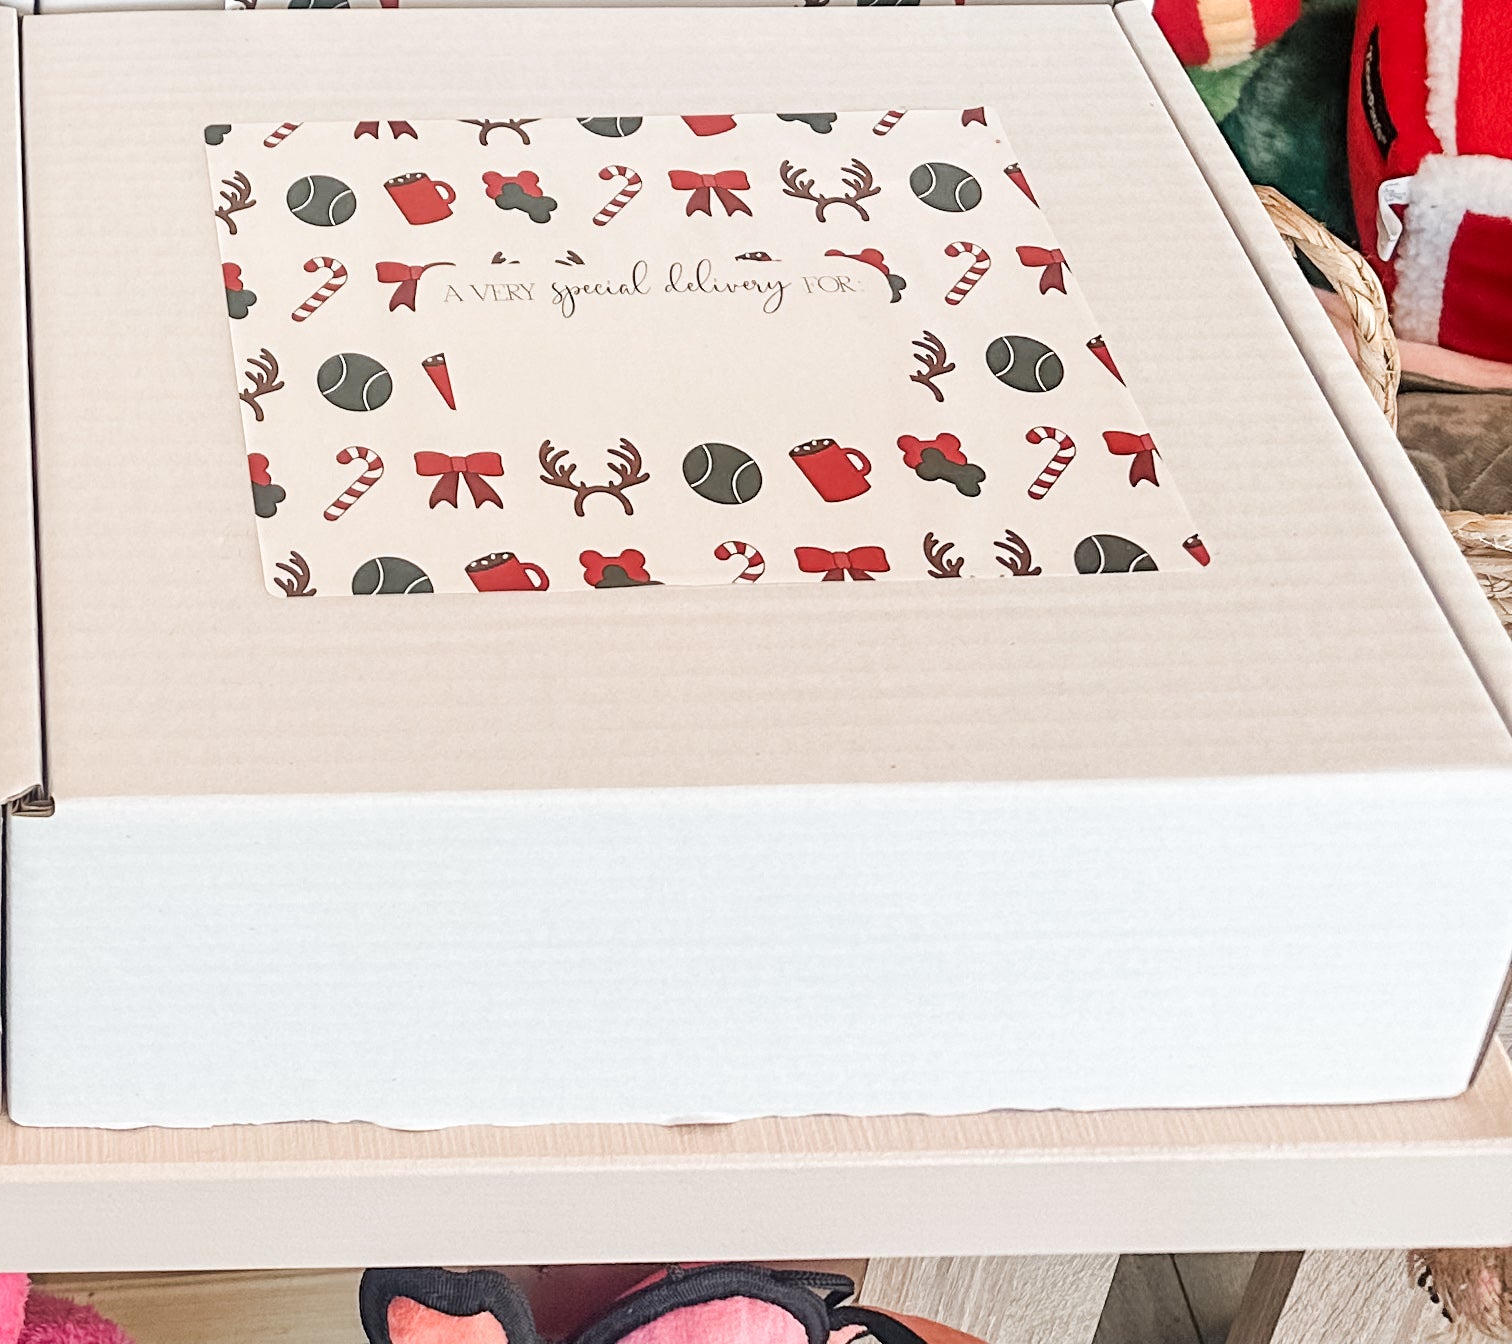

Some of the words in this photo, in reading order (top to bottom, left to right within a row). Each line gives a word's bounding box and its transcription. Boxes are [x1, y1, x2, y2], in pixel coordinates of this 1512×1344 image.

[443, 284, 464, 303] A
[469, 281, 537, 302] VERY
[552, 260, 651, 318] special
[664, 258, 791, 314] delivery
